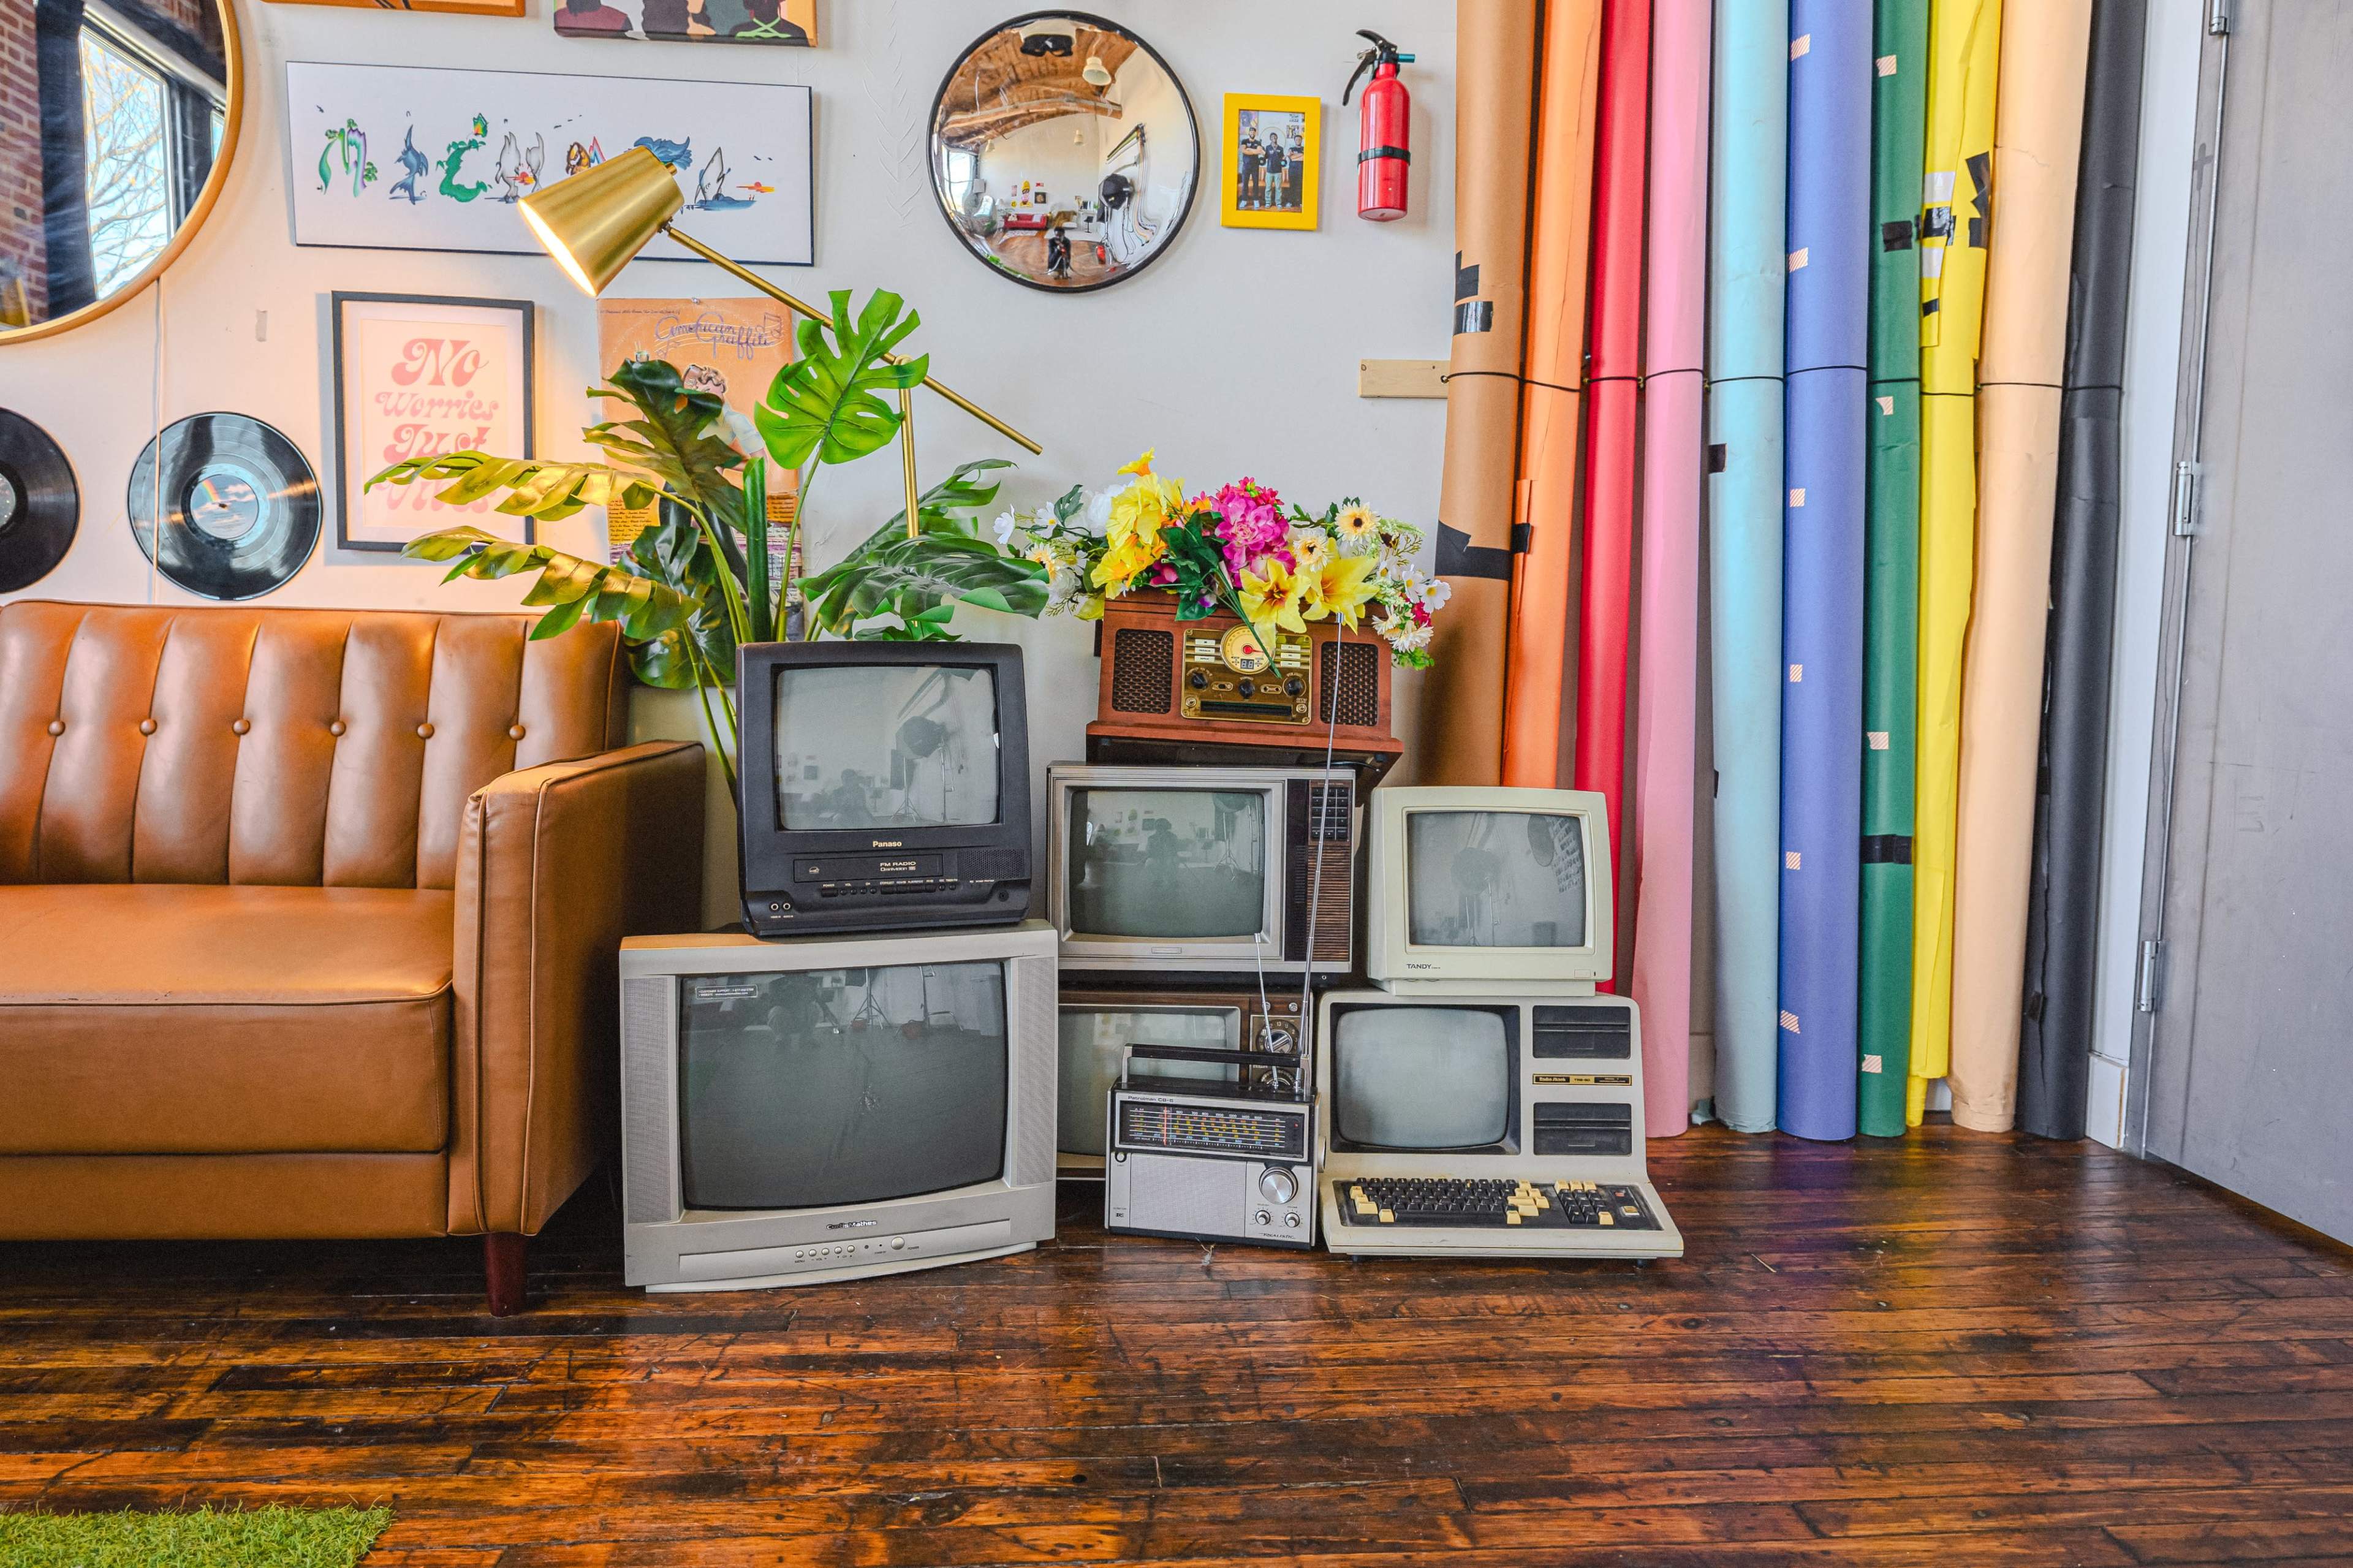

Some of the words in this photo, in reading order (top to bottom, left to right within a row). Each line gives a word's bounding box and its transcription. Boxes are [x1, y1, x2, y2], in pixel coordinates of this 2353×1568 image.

[391, 338, 490, 387] No
[374, 390, 499, 421] Worries
[383, 423, 491, 464] Just
